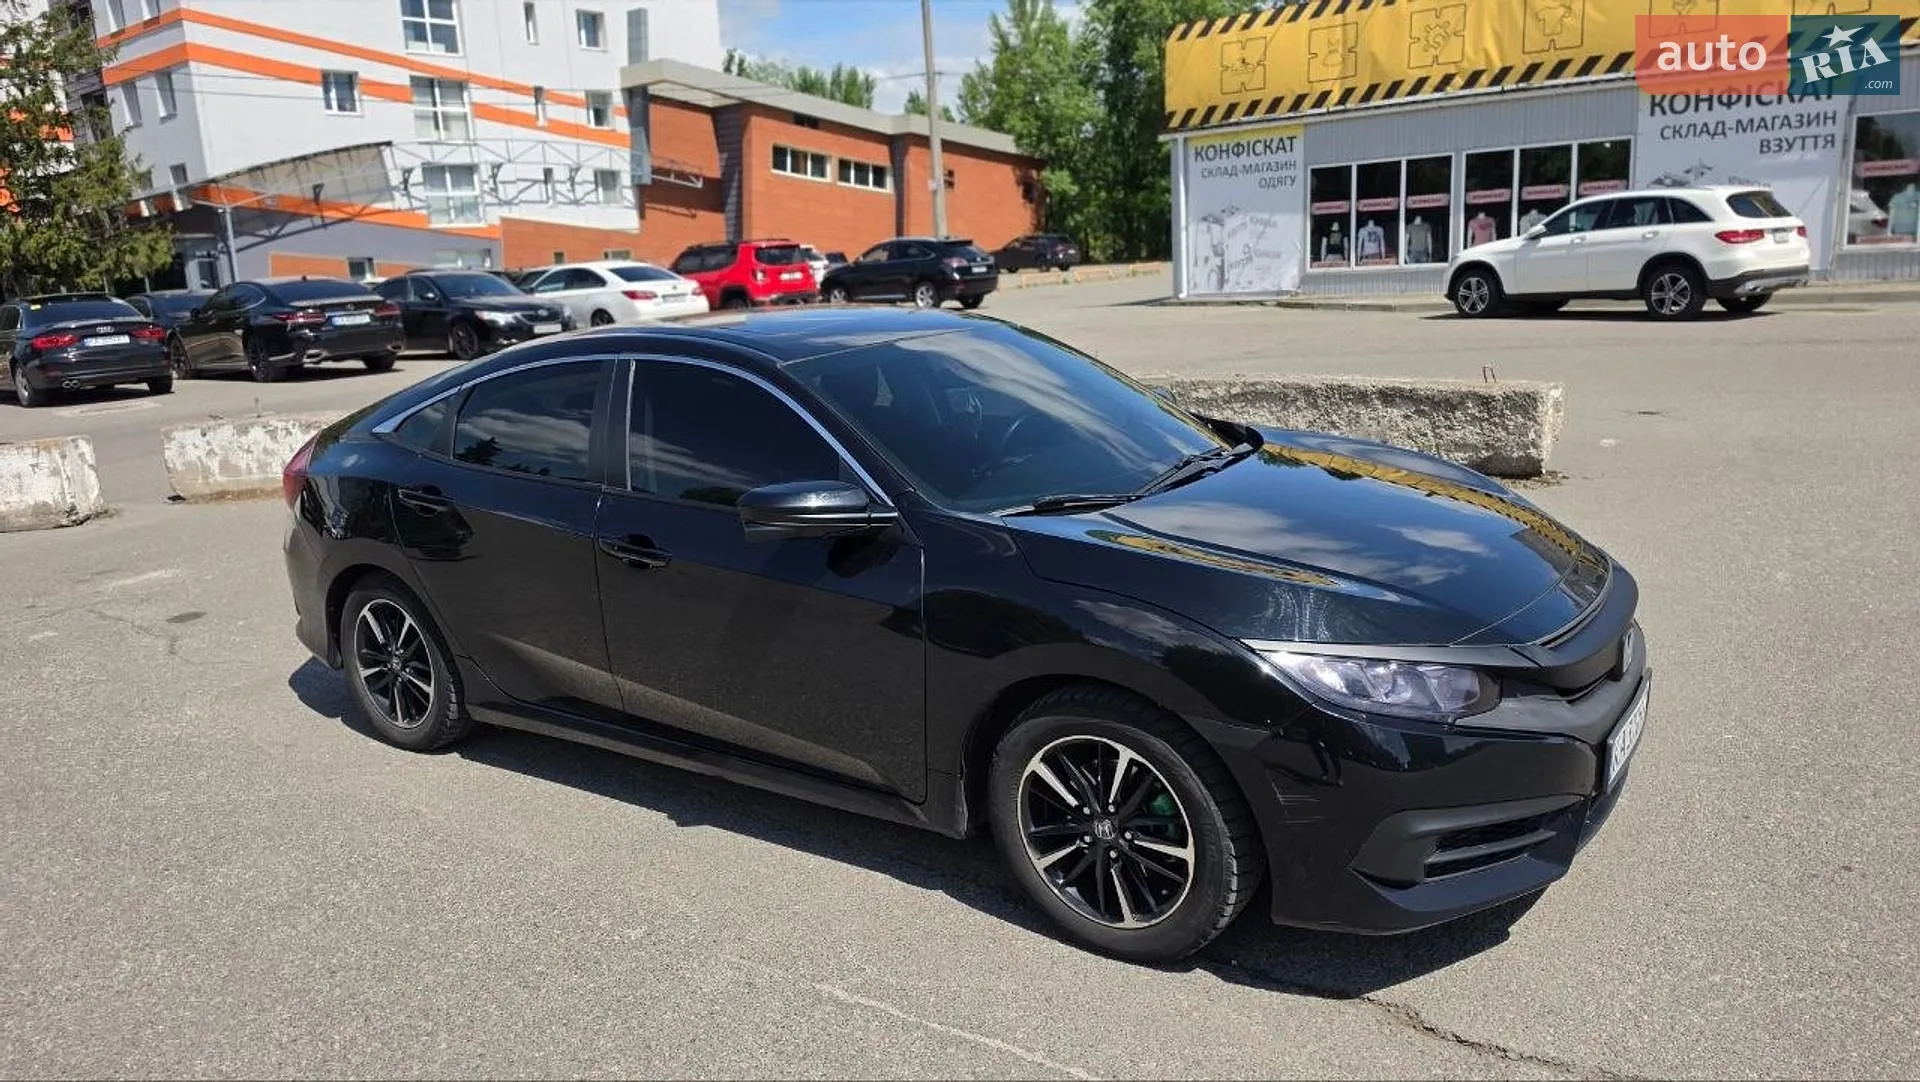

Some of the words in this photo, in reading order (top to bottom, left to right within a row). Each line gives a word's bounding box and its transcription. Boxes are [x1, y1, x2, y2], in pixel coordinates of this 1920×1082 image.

[1649, 78, 1836, 117] КОНФІСКАТ
[1660, 109, 1837, 141] СКЛАД-МАГАЗИН
[1194, 136, 1297, 163] КОНФІСКАТ
[1759, 133, 1836, 155] ВЗУТТЯ
[1200, 160, 1297, 179] СКЛАД-МАГАЗИН
[1258, 175, 1297, 190] ОДЯГУ
